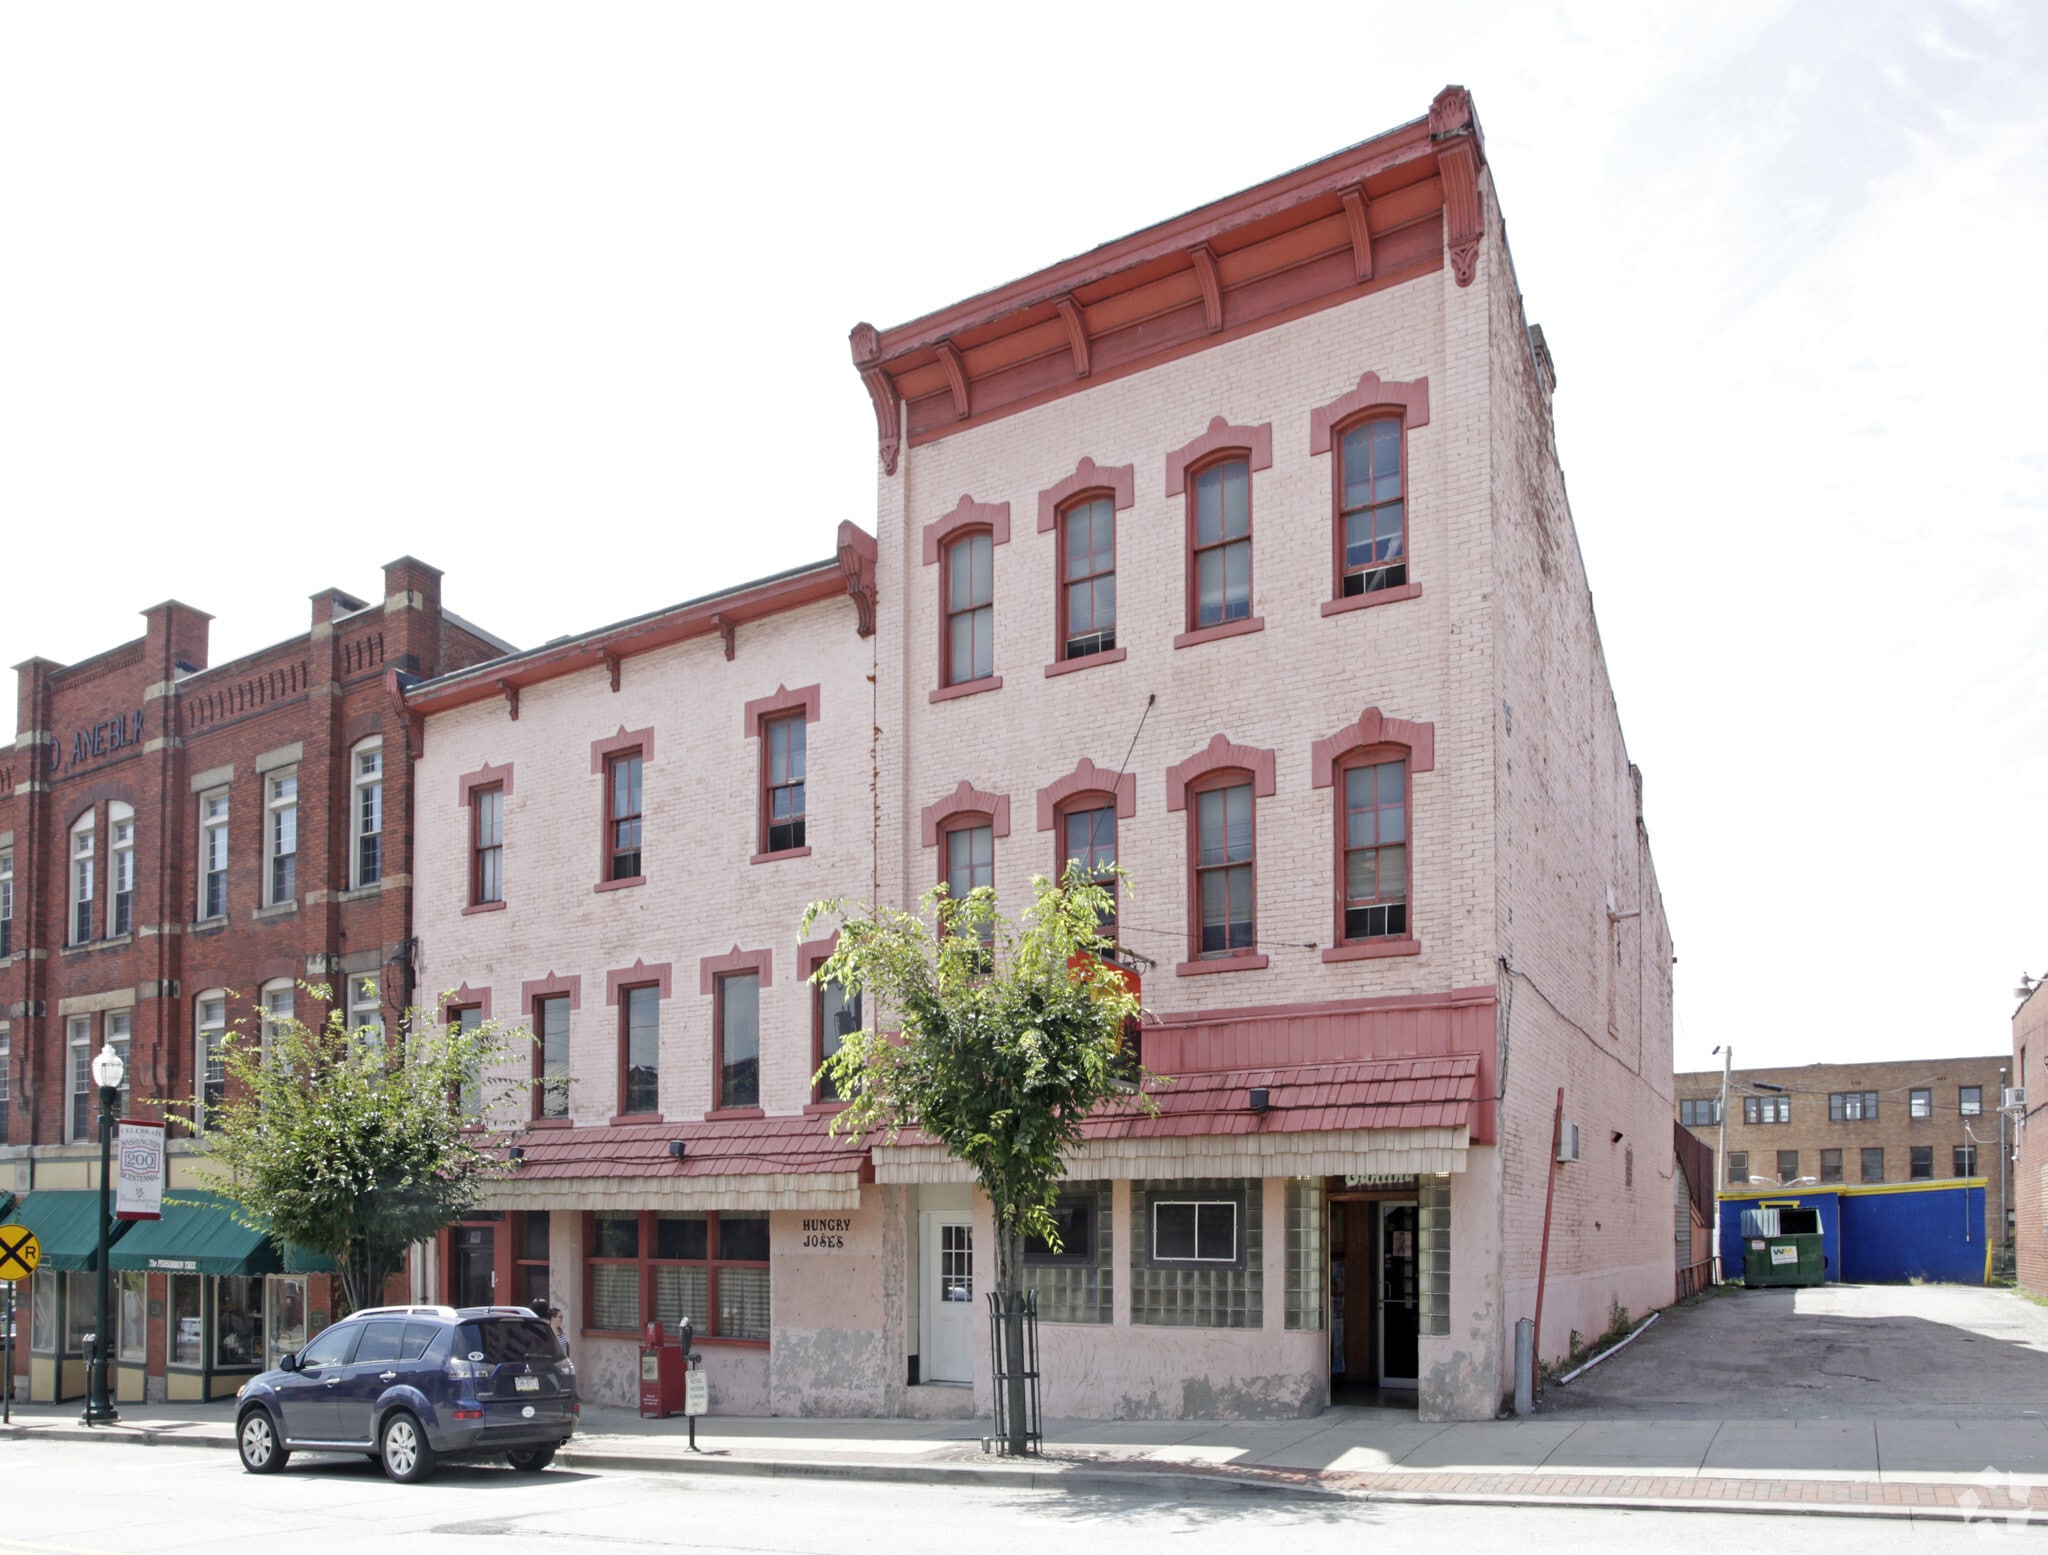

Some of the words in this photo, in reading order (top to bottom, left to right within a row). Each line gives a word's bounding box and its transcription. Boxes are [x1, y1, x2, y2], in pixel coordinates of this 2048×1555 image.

[120, 1139, 161, 1148] WASHINGTON
[127, 1152, 154, 1167] 200
[803, 1218, 851, 1231] HUNGRY
[25, 1246, 36, 1260] R
